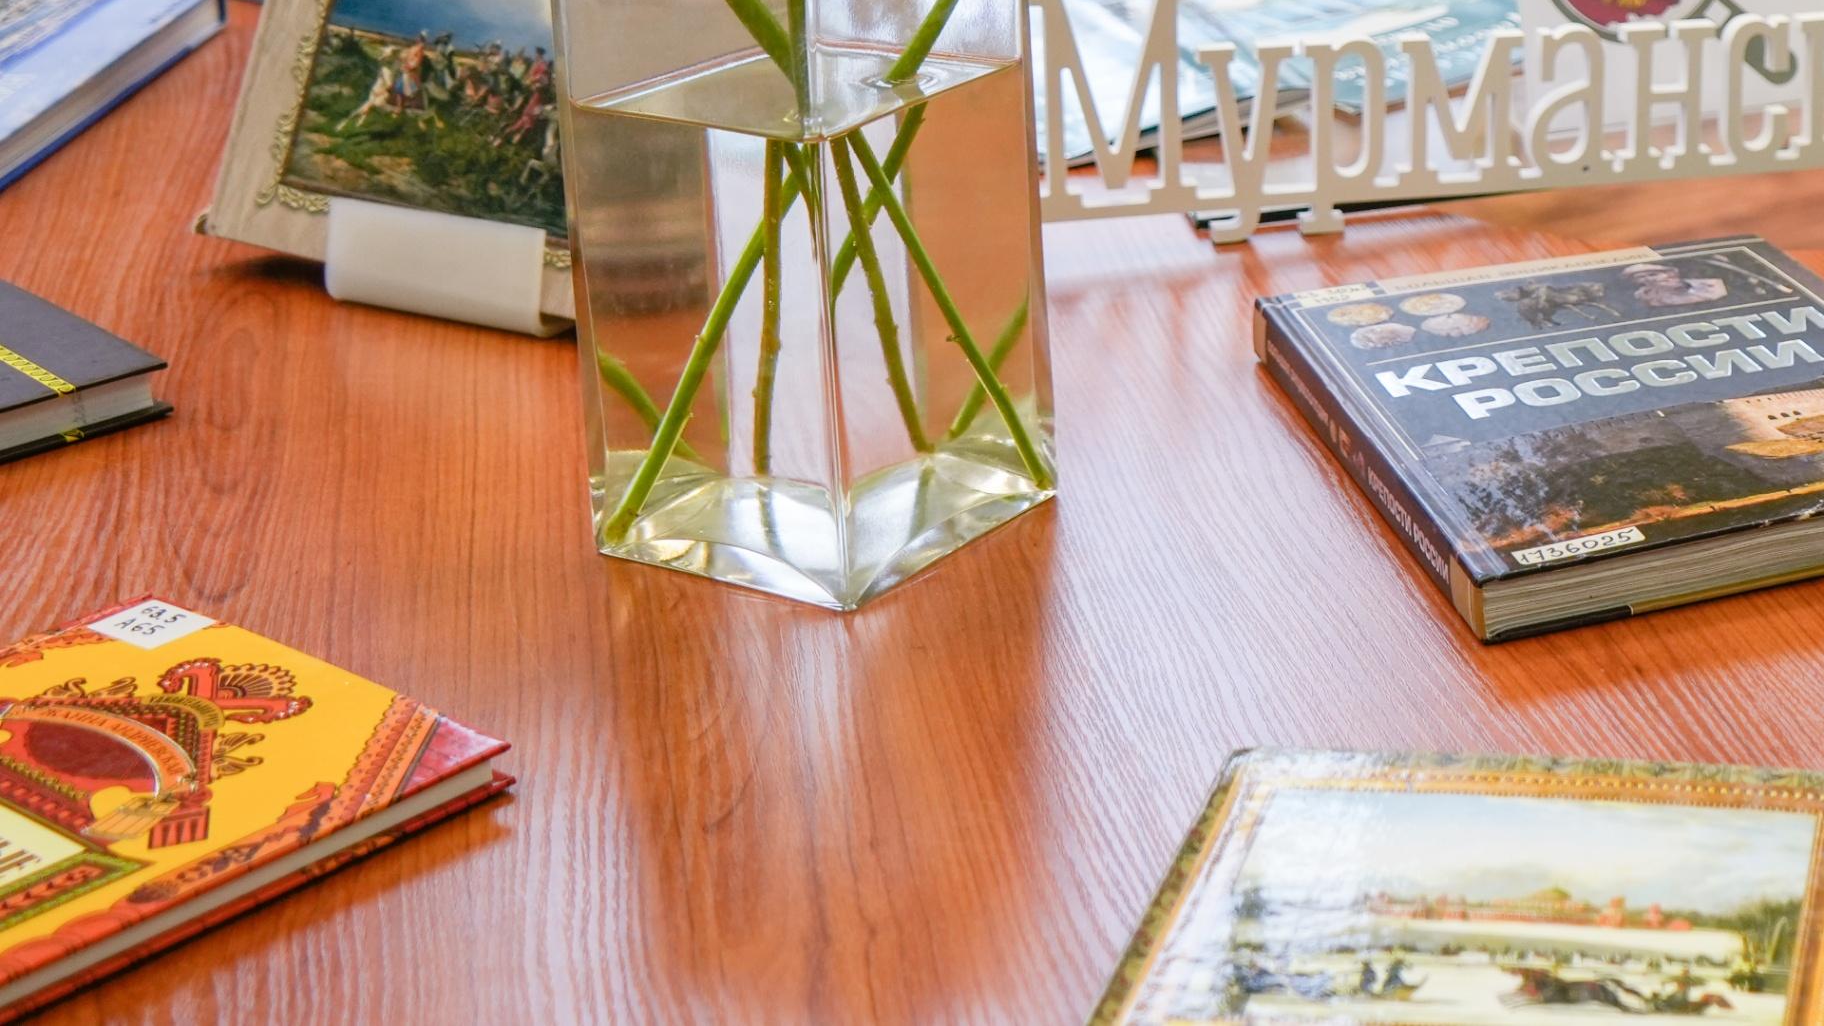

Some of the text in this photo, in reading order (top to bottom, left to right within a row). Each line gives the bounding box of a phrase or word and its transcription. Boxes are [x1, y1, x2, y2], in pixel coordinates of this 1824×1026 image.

[1366, 465, 1450, 585] КРЕПОСТИ РОССИИ
[1520, 528, 1635, 564] 1736025
